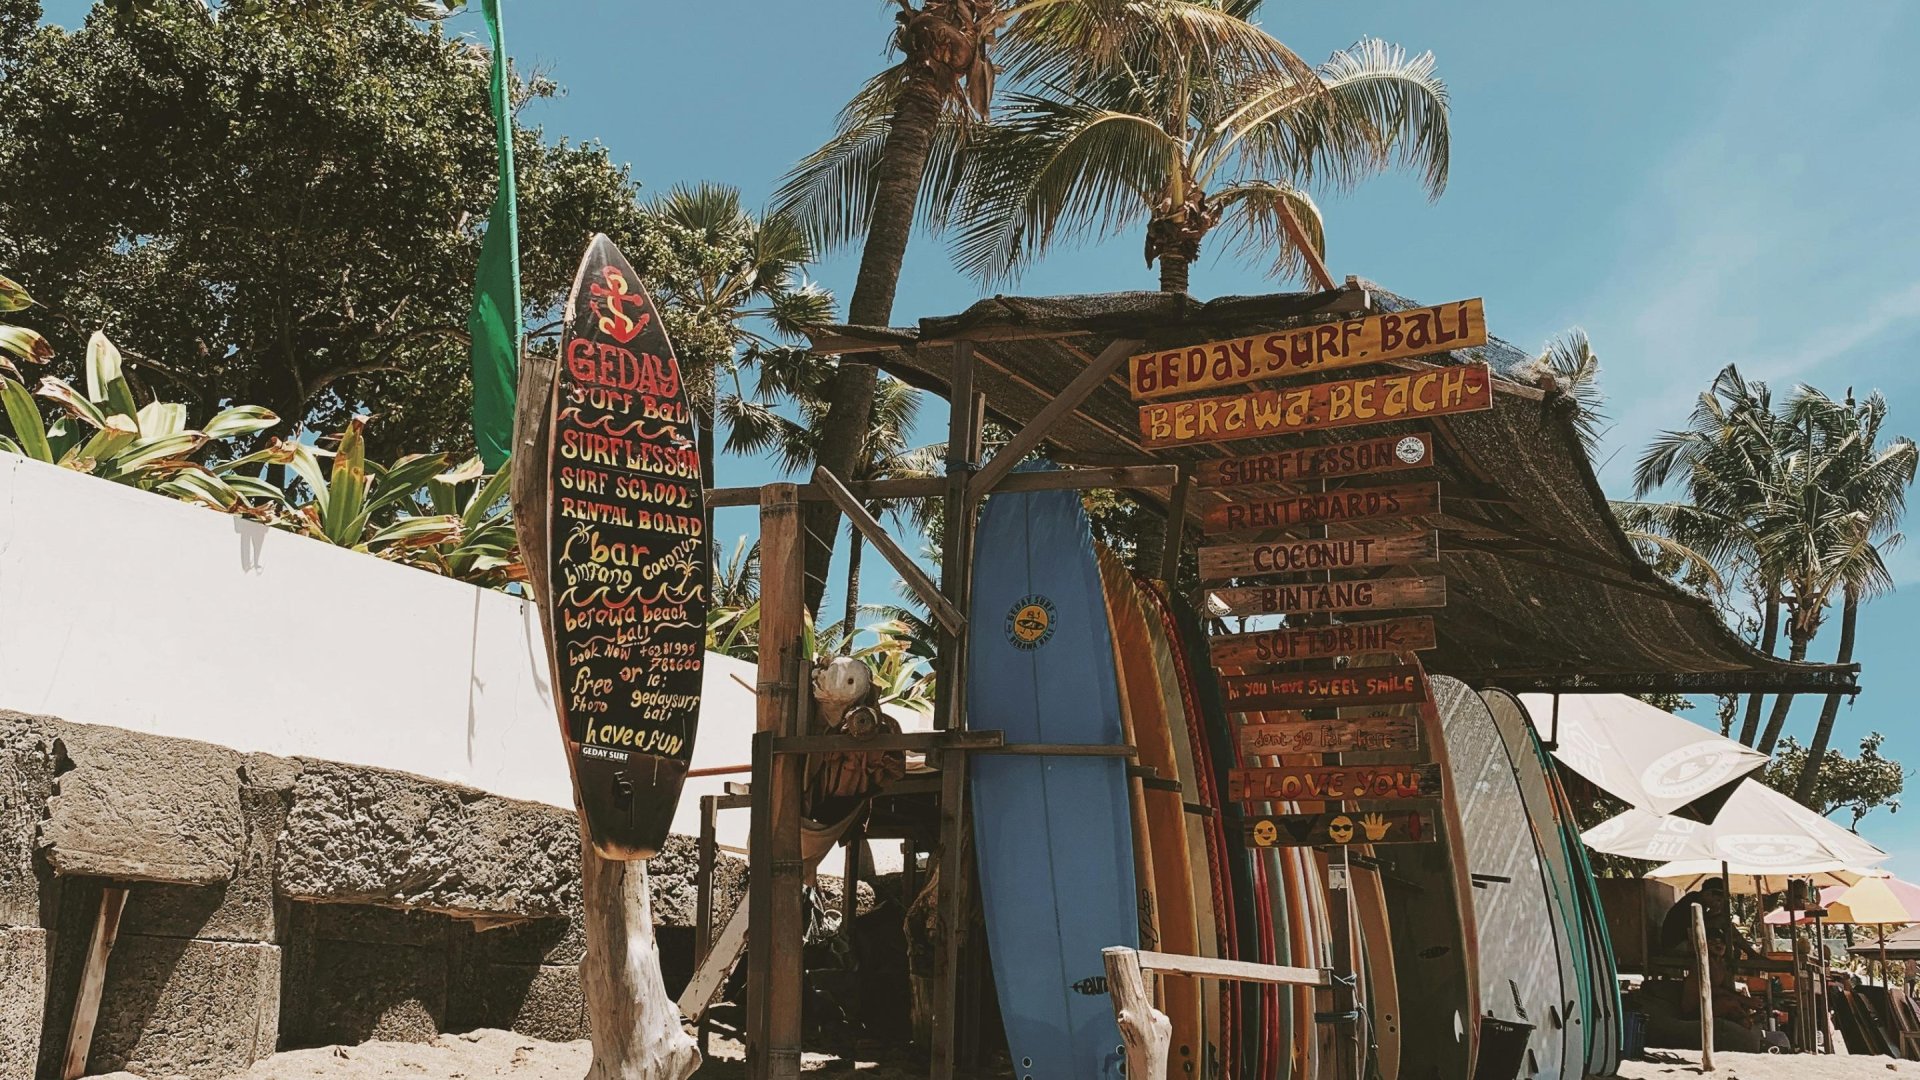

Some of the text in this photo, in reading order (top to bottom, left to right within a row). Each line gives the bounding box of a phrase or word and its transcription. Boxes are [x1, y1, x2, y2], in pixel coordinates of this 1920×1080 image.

[568, 338, 679, 398] GEDAY
[561, 429, 699, 479] SURF LESSON
[1219, 443, 1393, 485] SURF LESSON
[560, 466, 608, 495] SURF
[561, 497, 702, 536] RENTAL BOARD
[1227, 500, 1297, 531] RENT
[590, 531, 650, 567] bar
[1253, 539, 1375, 572] COCONUT
[1261, 583, 1373, 612] BINTANG
[565, 604, 688, 632] berawa beach
[617, 624, 648, 645] bali
[1321, 623, 1405, 652] DRINK
[569, 642, 602, 666] book
[570, 666, 613, 697] free
[619, 667, 643, 682] or
[630, 689, 700, 712] gedaysurf
[1228, 681, 1240, 700] hi
[1245, 682, 1268, 697] you
[1272, 680, 1303, 694] have
[643, 706, 672, 721] bali
[585, 717, 634, 746] have
[634, 730, 645, 747] a
[582, 747, 629, 761] GEDAY SURF
[1243, 771, 1421, 798] I LOVE YOU
[1646, 841, 1685, 856] BALI
